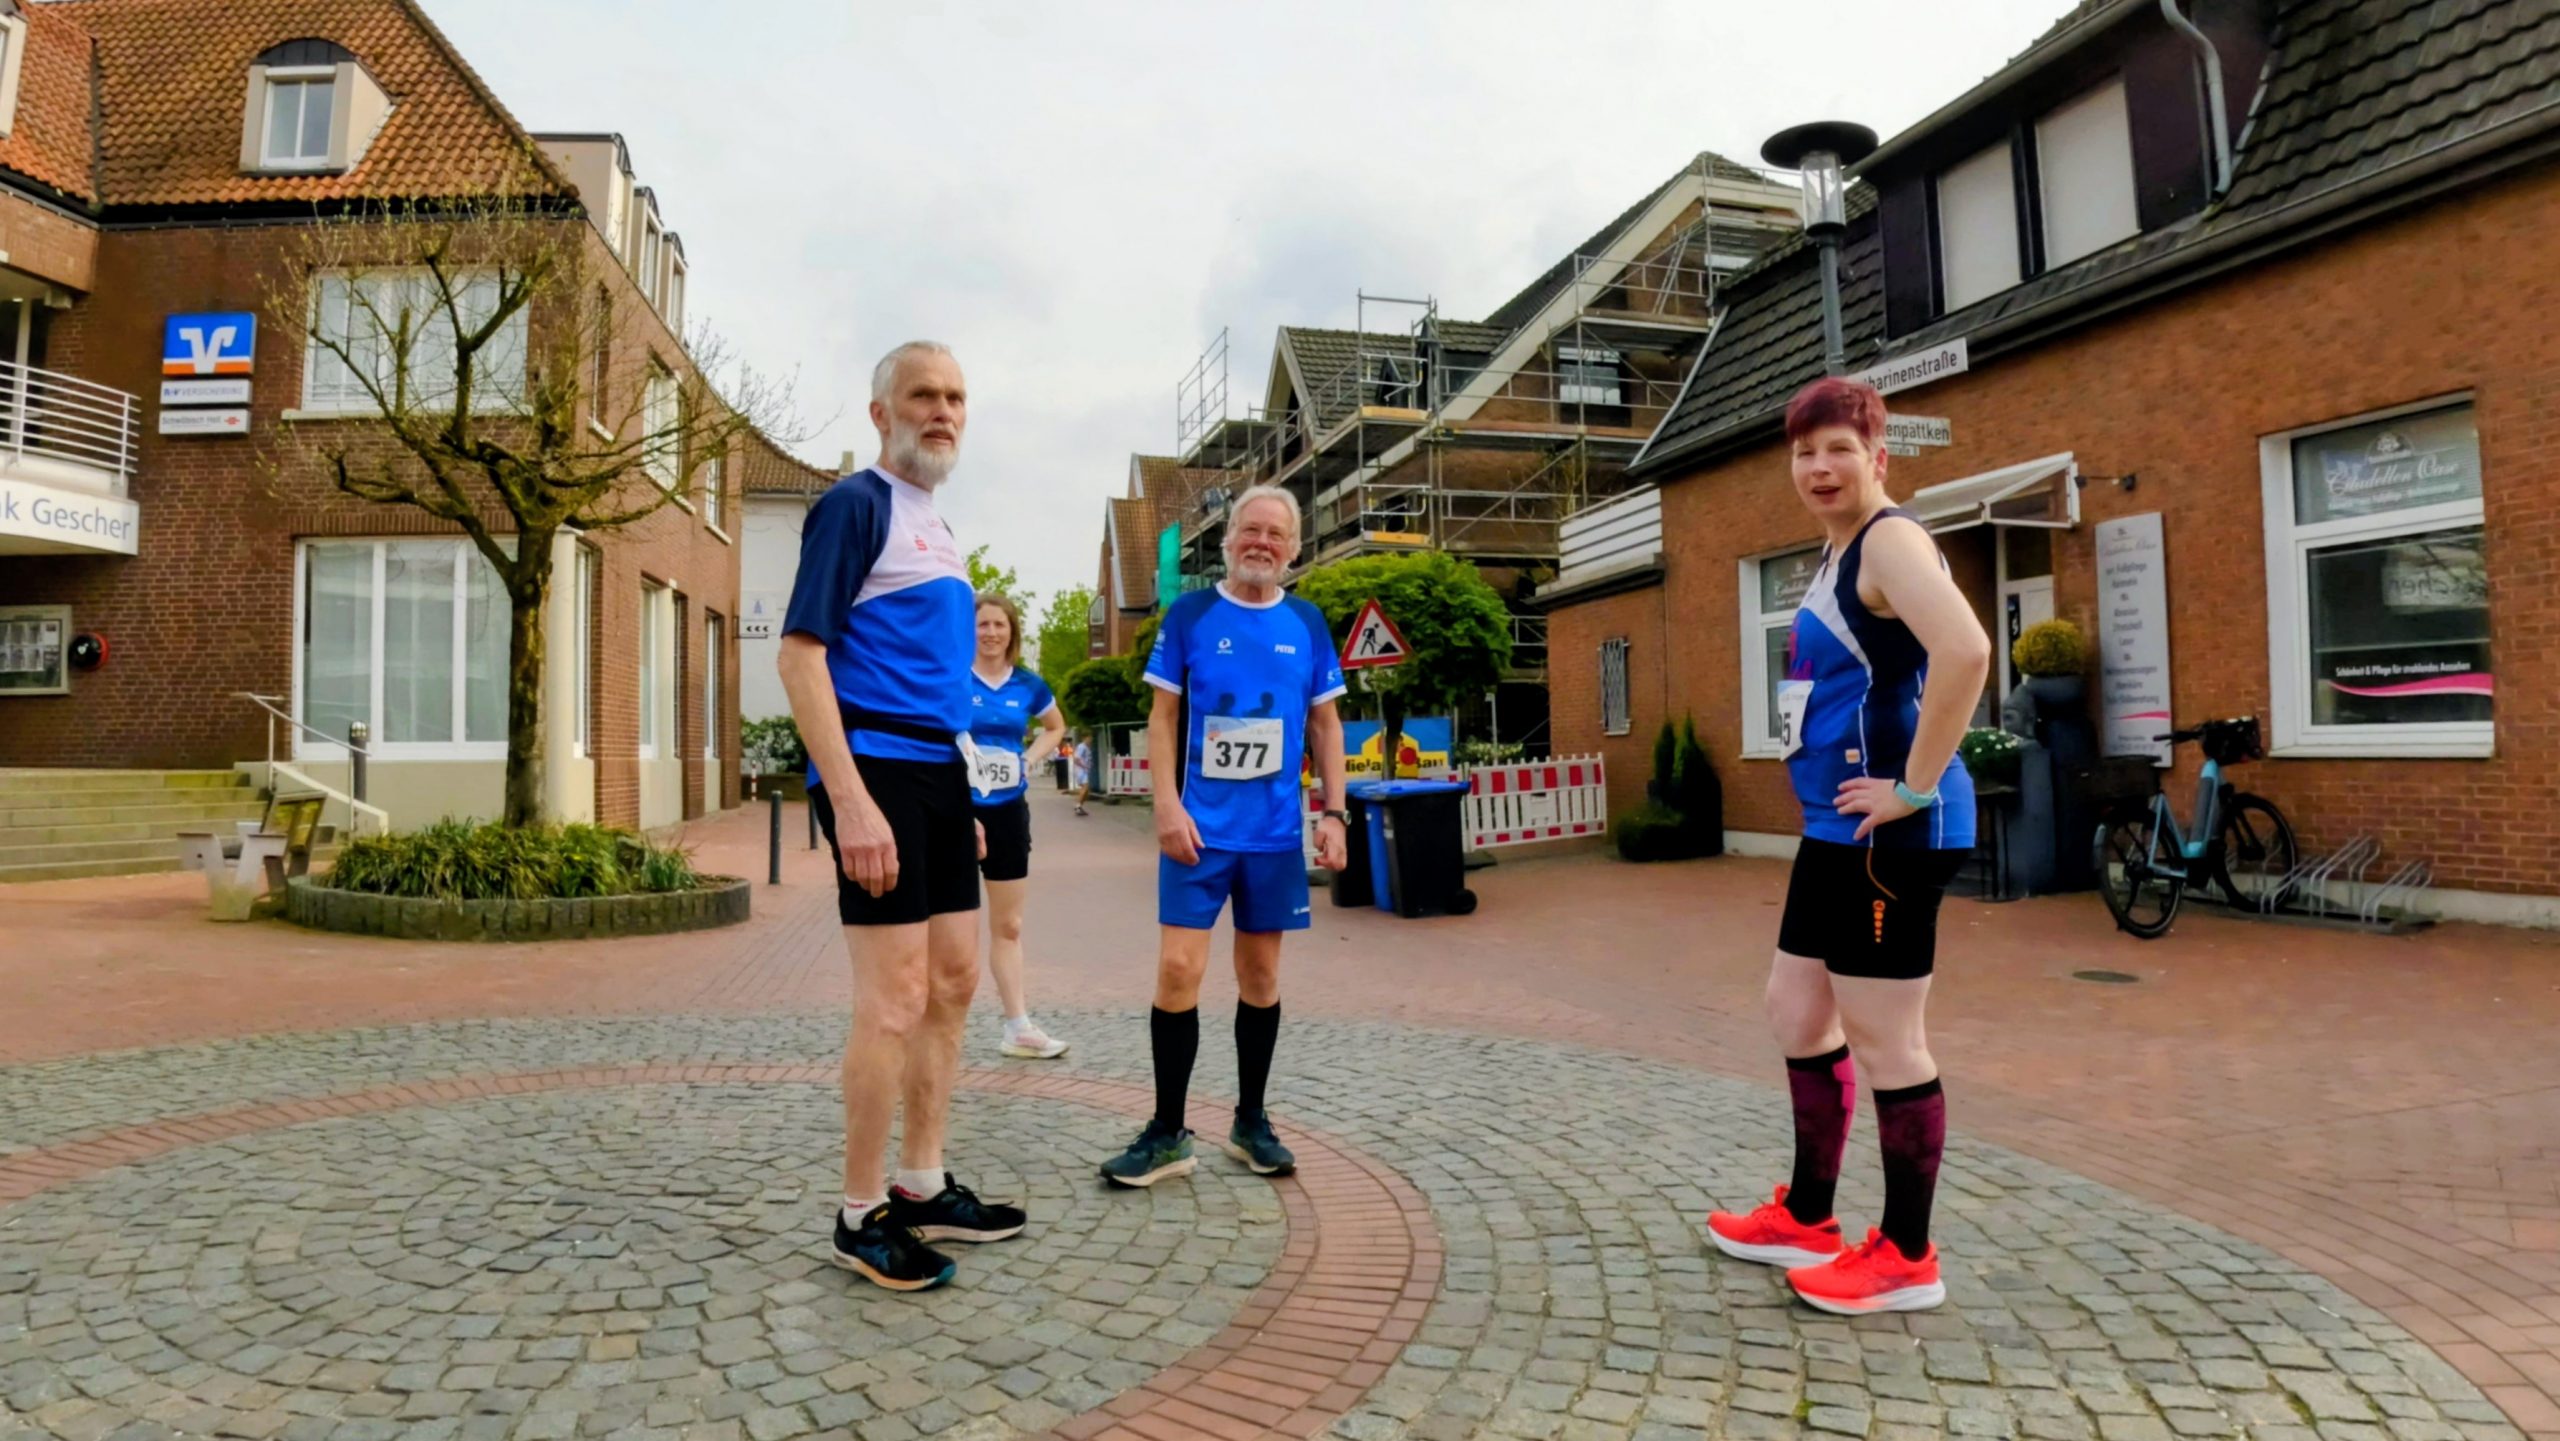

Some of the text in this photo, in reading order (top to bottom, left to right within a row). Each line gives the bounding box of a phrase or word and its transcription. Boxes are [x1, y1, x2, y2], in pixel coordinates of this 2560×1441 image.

[1864, 349, 1958, 392] harinenstraße
[32, 497, 131, 540] Gescher
[1215, 740, 1269, 769] 377
